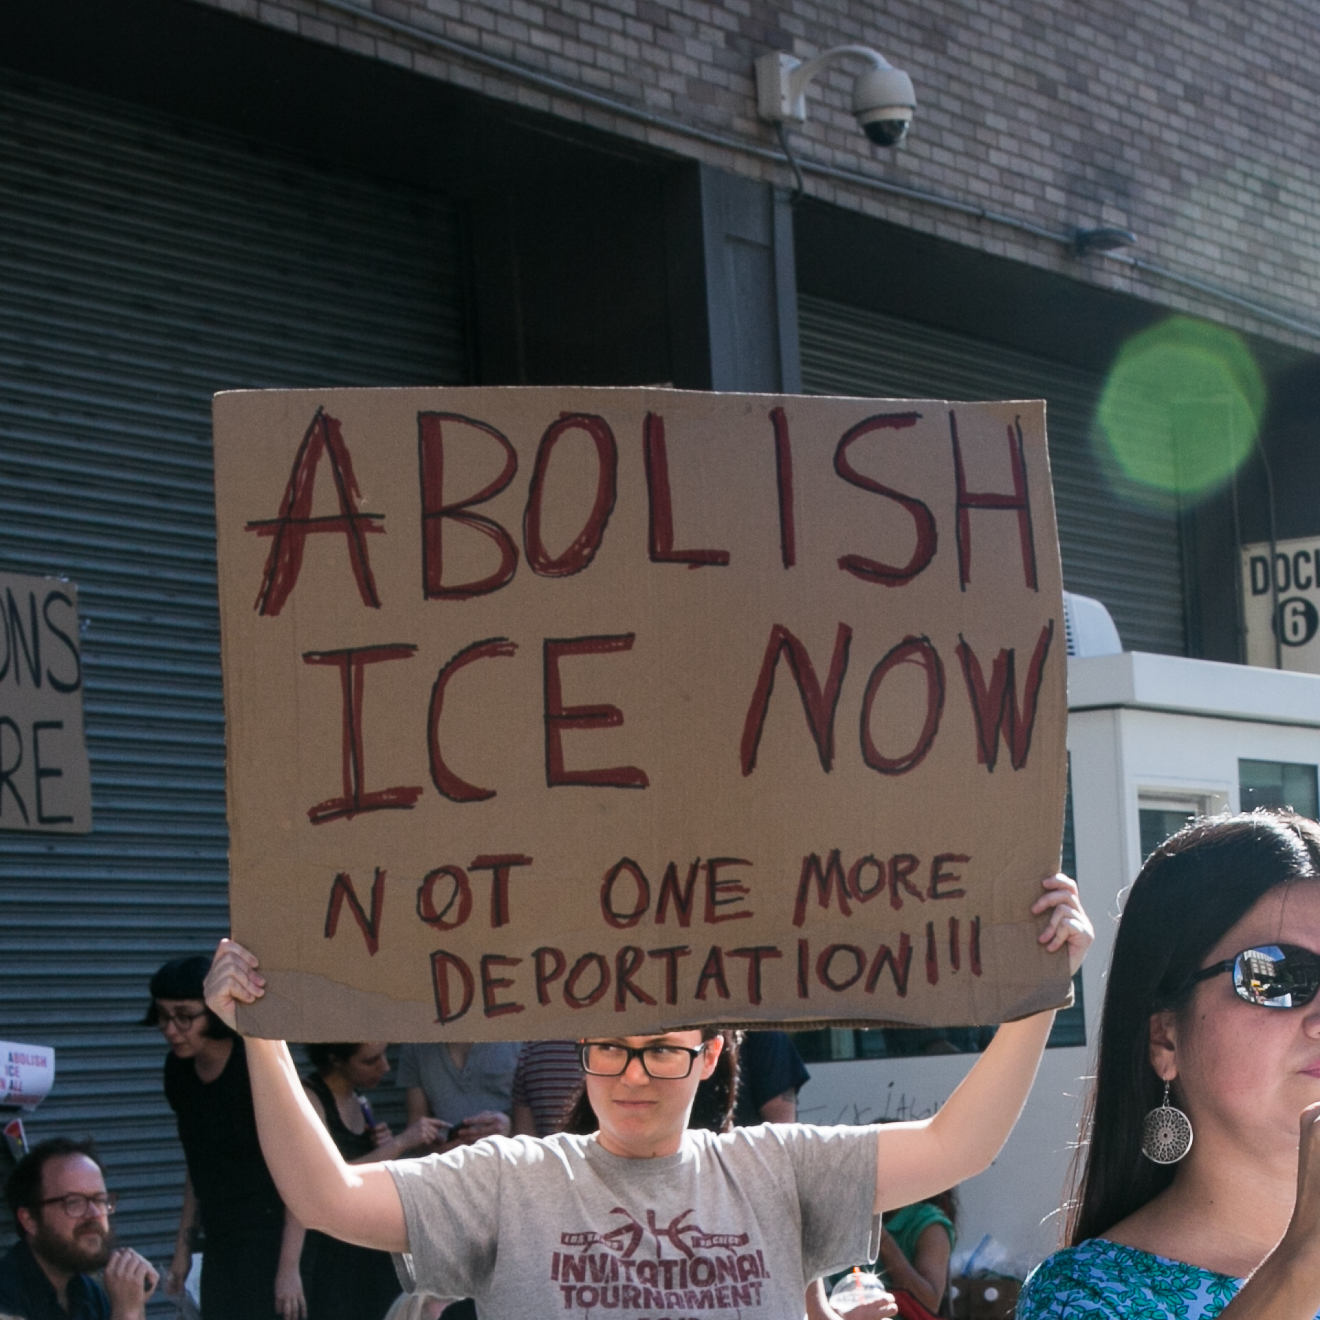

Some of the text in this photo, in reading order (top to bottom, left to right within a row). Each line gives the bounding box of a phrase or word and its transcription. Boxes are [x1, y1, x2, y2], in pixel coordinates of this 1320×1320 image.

[244, 405, 1041, 617] ABOLISH
[1283, 600, 1308, 643] 6
[301, 618, 1056, 825] ICE NOW
[323, 847, 974, 956] NOT ONE MORE
[550, 1249, 771, 1290] INVITATIONAL
[559, 1281, 763, 1310] TOURNAMENT
